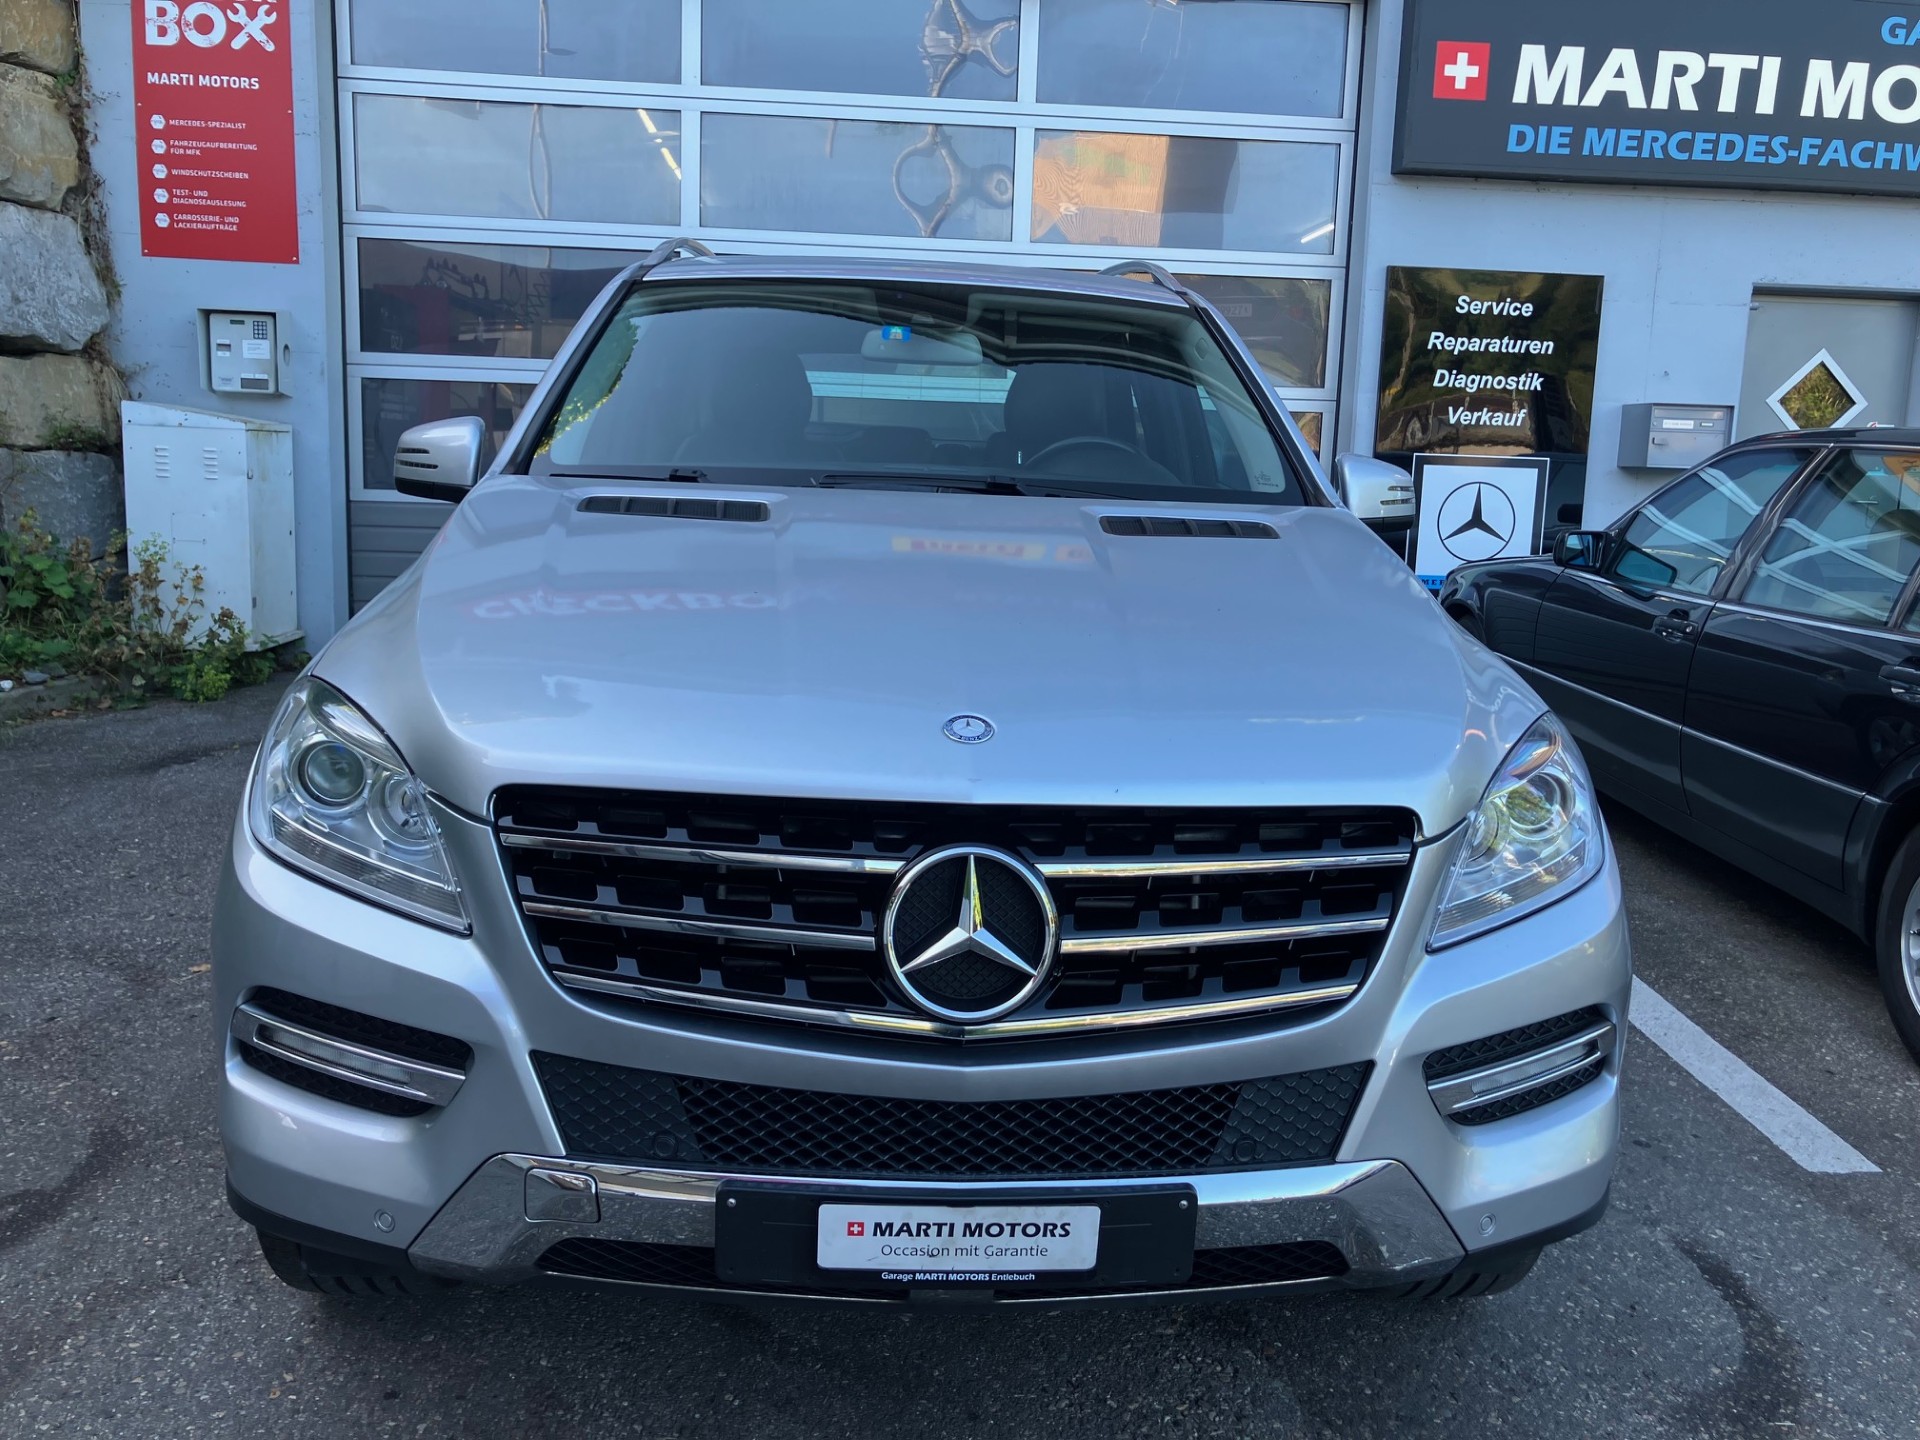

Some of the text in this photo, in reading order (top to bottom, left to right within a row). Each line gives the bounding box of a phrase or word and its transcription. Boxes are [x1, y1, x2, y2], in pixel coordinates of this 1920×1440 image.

[147, 72, 260, 90] MARTI MOTORS
[1512, 44, 1920, 124] MARTI MO
[169, 119, 247, 129] MERCEDES-SPEZIALIST
[170, 140, 258, 151] FAHRZEUGAUFBEREITUNG
[1507, 124, 1574, 155] DIE
[171, 147, 184, 155] FÜR
[172, 169, 249, 179] WINDSCHUTZSCHEIBEN
[173, 198, 247, 208] DIAGNOSEAUSLESUNG
[174, 214, 223, 223] CARROSSERIE-
[174, 222, 238, 231] LACKIERAUFTRÄGE
[1456, 296, 1534, 317] Service
[1428, 332, 1554, 355] Reparaturen
[1434, 369, 1544, 393] Diagnostik
[1448, 407, 1527, 427] Verkauf
[873, 1222, 1071, 1238] MARTI MOTORS
[881, 1244, 1049, 1257] Occasion mit Garantie
[882, 1272, 1036, 1282] Garage MARTI MOTORS Entlebuch
